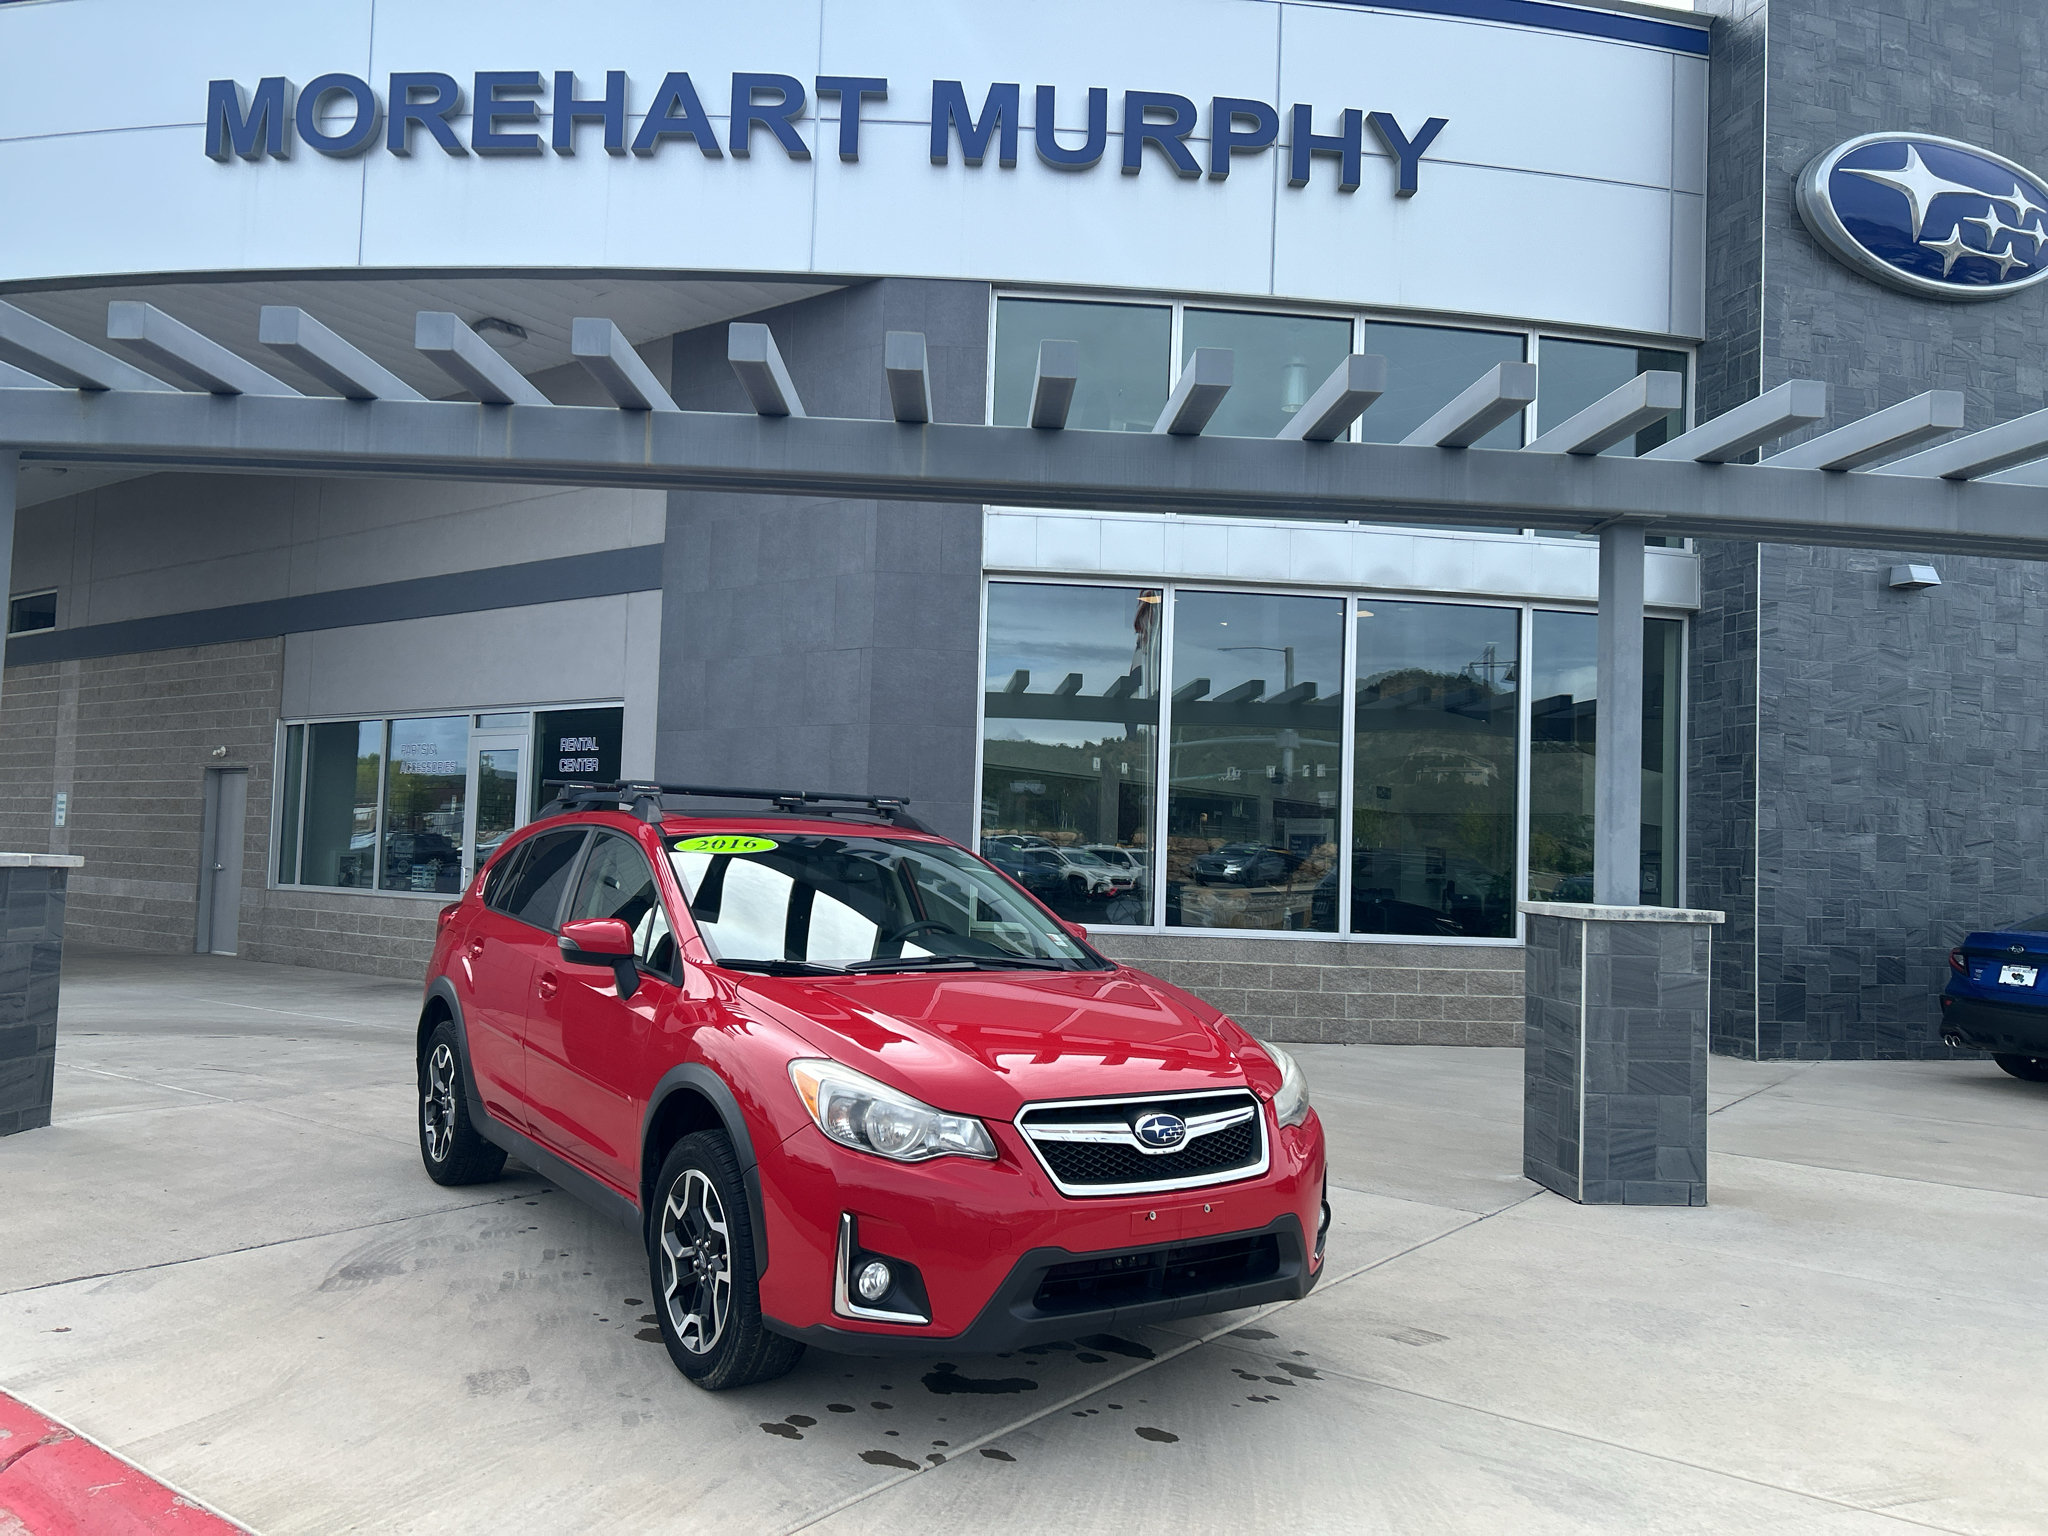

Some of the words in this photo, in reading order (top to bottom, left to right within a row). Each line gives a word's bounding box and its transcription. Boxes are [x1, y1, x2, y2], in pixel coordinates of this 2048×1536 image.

[205, 70, 888, 162] MOREHART
[930, 79, 1449, 198] MURPHY
[560, 737, 599, 751] RENTAL
[400, 760, 457, 775] ACCESSORIES
[559, 758, 598, 772] CENTER
[694, 839, 757, 850] 2016
